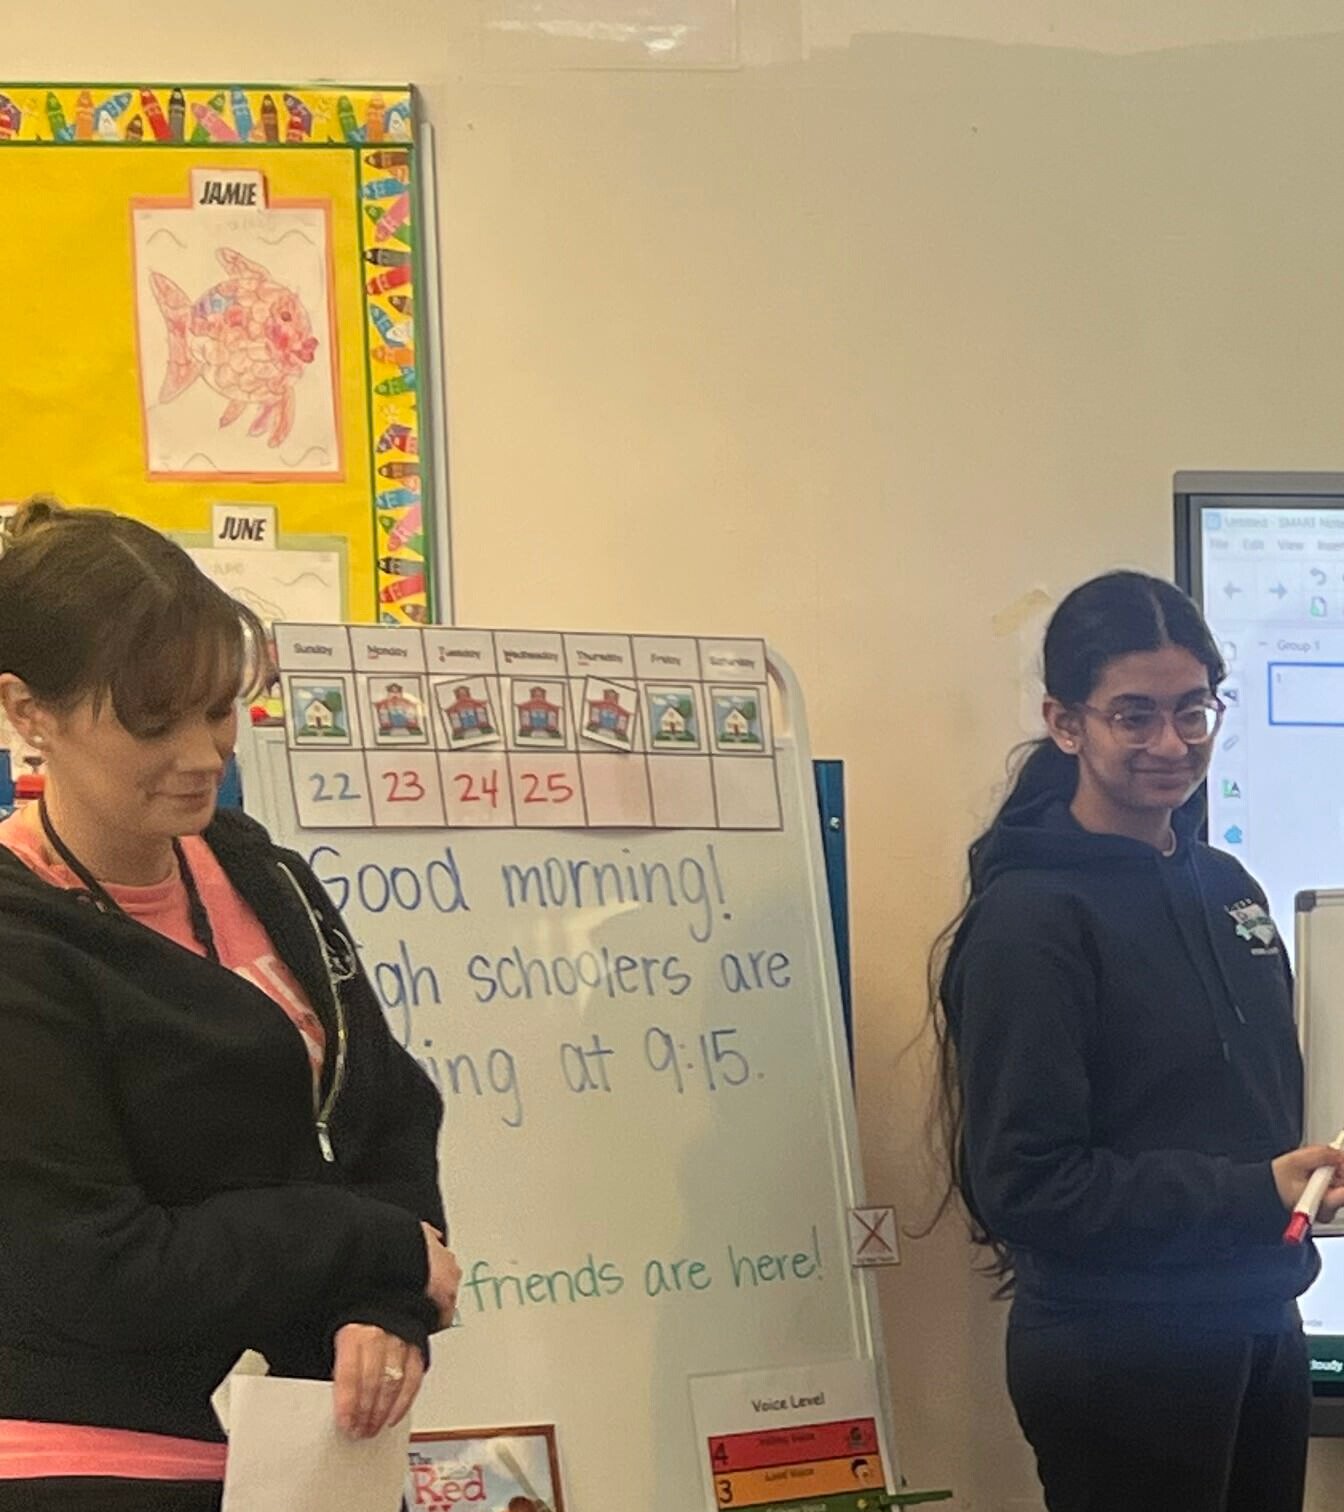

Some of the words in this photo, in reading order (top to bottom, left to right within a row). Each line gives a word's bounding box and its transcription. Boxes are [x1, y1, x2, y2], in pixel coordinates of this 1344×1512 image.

[200, 181, 257, 206] JAMIE
[219, 517, 267, 541] JUNE
[293, 643, 333, 656] Sunday
[367, 645, 408, 657] Monday
[651, 653, 682, 666] Friday
[1277, 639, 1311, 654] Group
[309, 772, 361, 802] 22
[382, 771, 425, 802] 23
[454, 769, 499, 808] 24
[520, 772, 574, 803] 25
[309, 846, 471, 913] Good
[503, 843, 732, 942] morning!
[375, 939, 442, 1050] gh
[468, 945, 692, 1002] schoolers
[721, 950, 791, 993] are
[561, 1033, 616, 1094] at
[644, 1026, 766, 1094] 9:15.
[464, 1253, 625, 1312] friends
[644, 1258, 713, 1297] are
[727, 1225, 824, 1287] here!
[752, 1398, 788, 1413] Voice
[791, 1392, 826, 1409] Level
[714, 1442, 729, 1465] 4
[410, 1464, 487, 1504] Red
[719, 1479, 733, 1503] 3
